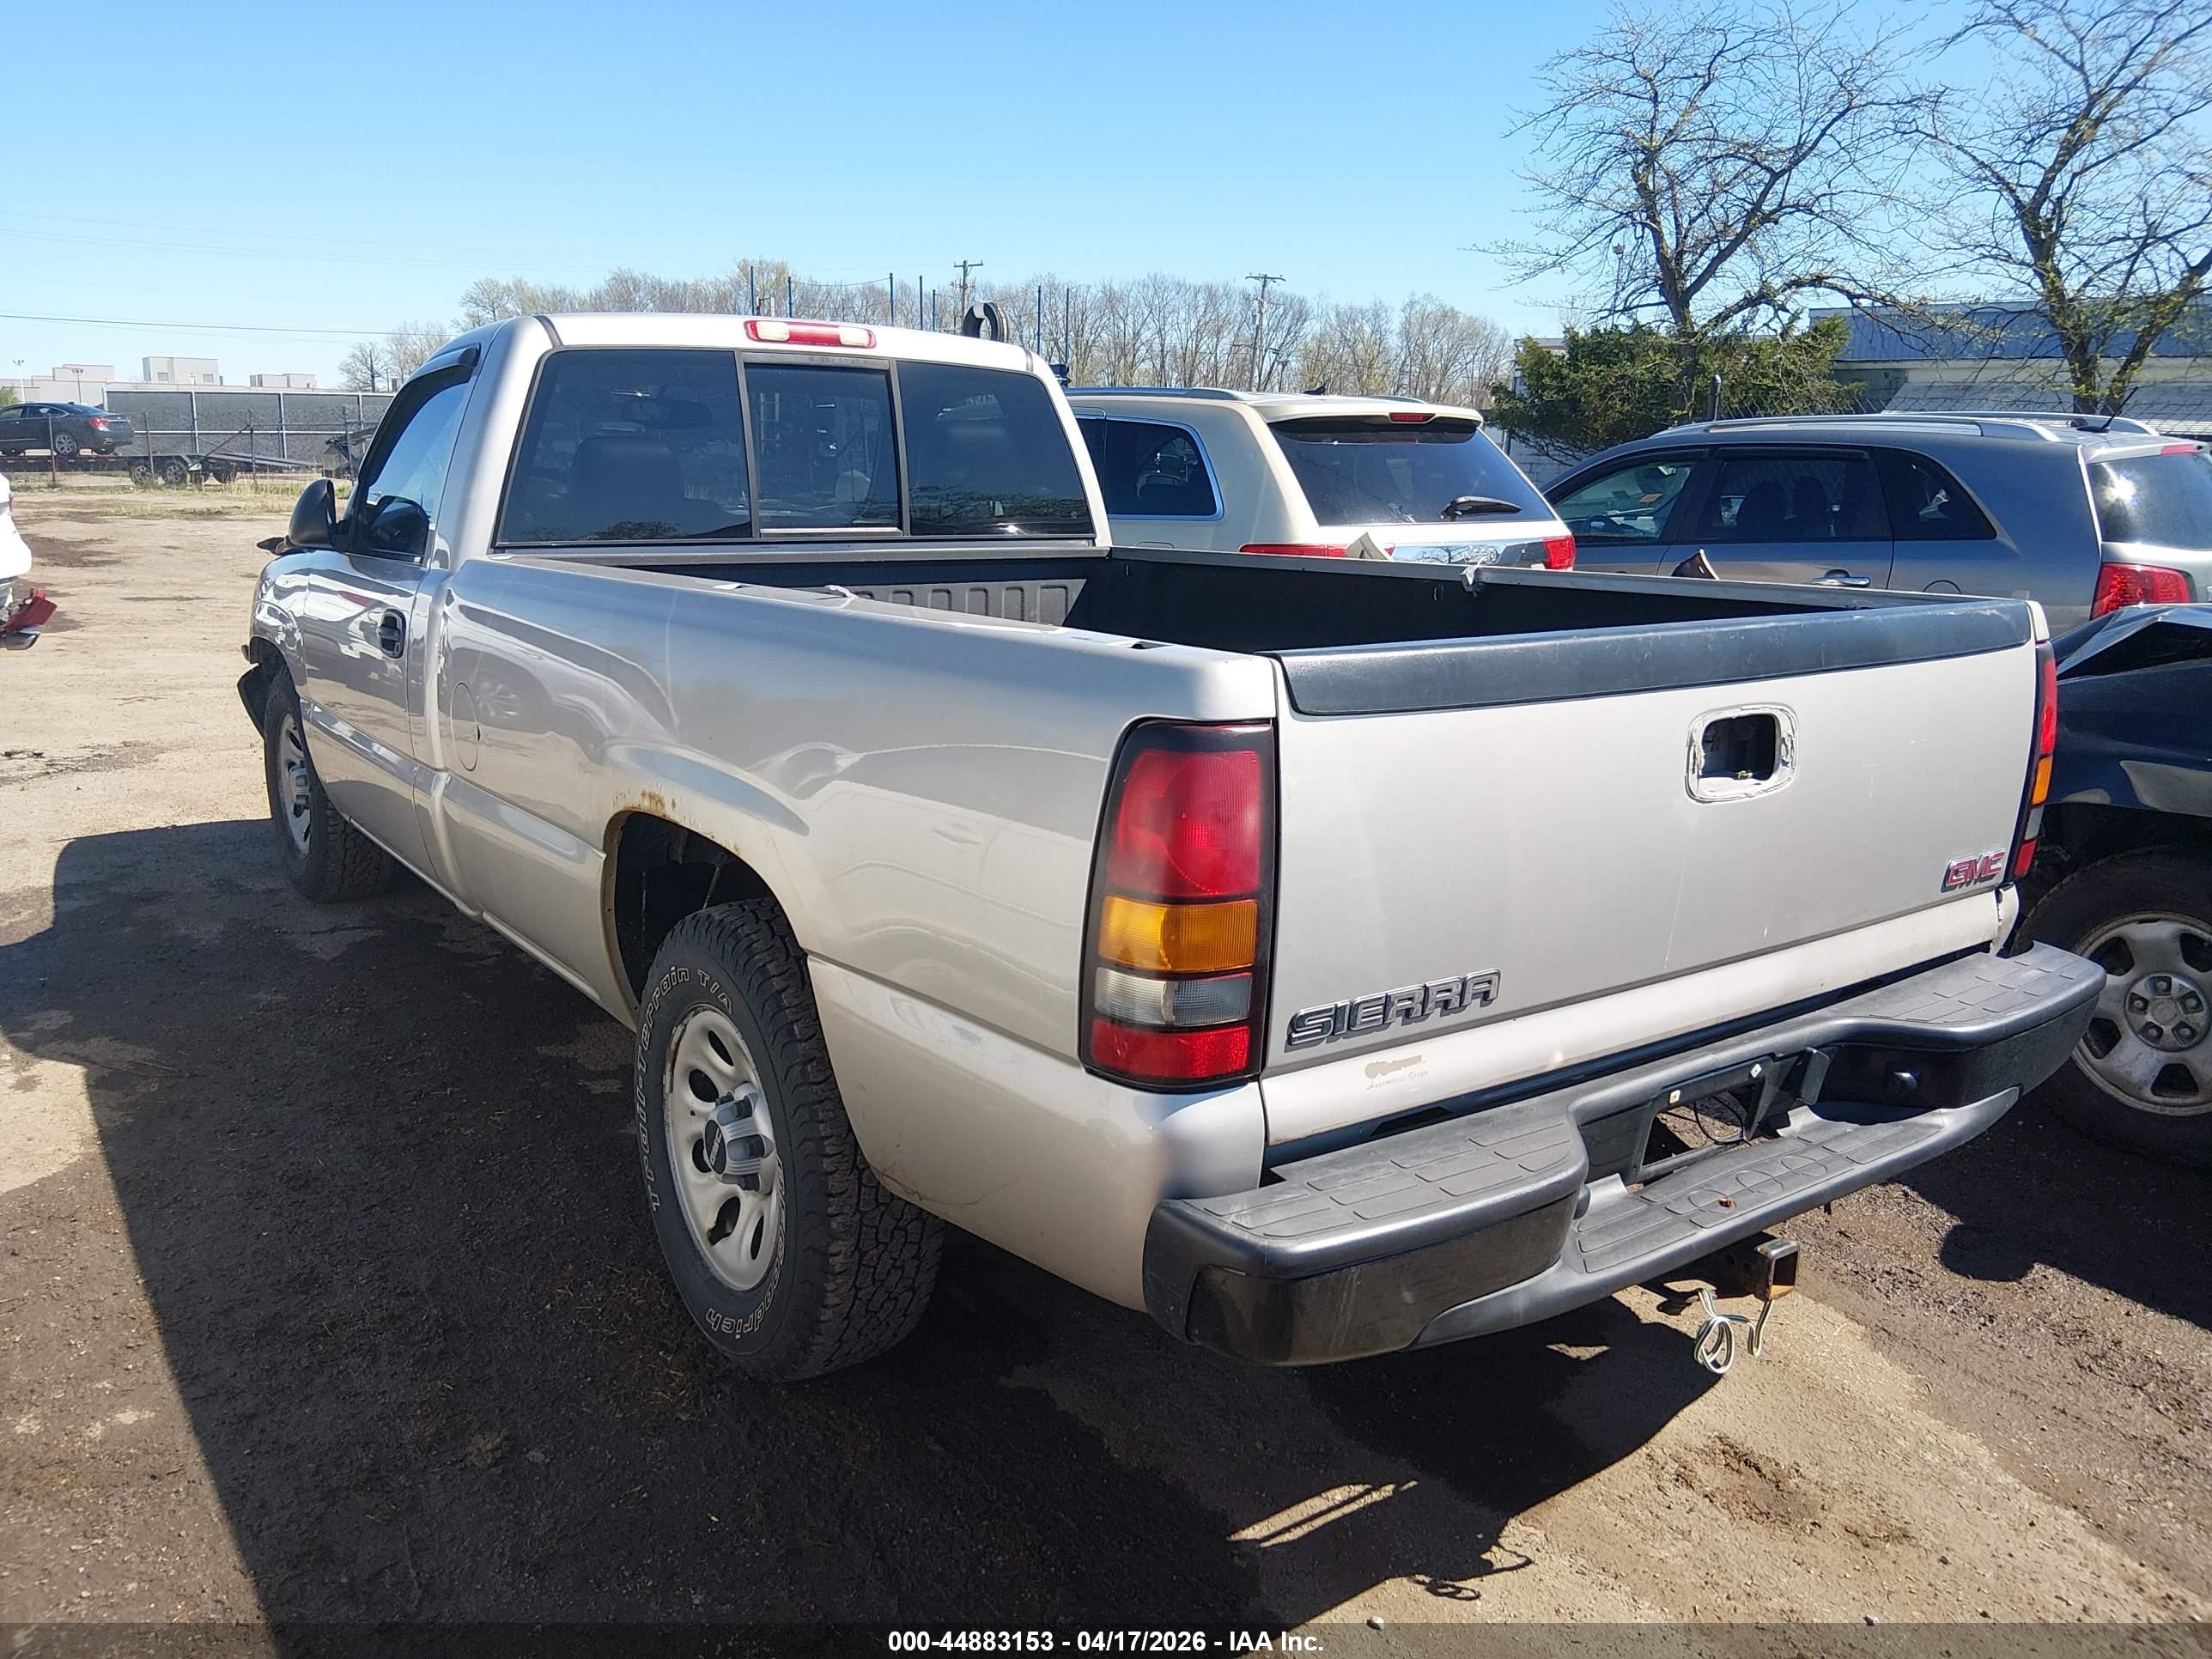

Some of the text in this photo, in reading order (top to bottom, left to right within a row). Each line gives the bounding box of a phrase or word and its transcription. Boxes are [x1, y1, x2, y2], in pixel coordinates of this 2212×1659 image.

[1943, 848, 2006, 889] GMC
[696, 969, 733, 1017] T/A
[1287, 968, 1501, 1047] SIERRA
[709, 1127, 723, 1166] GMC
